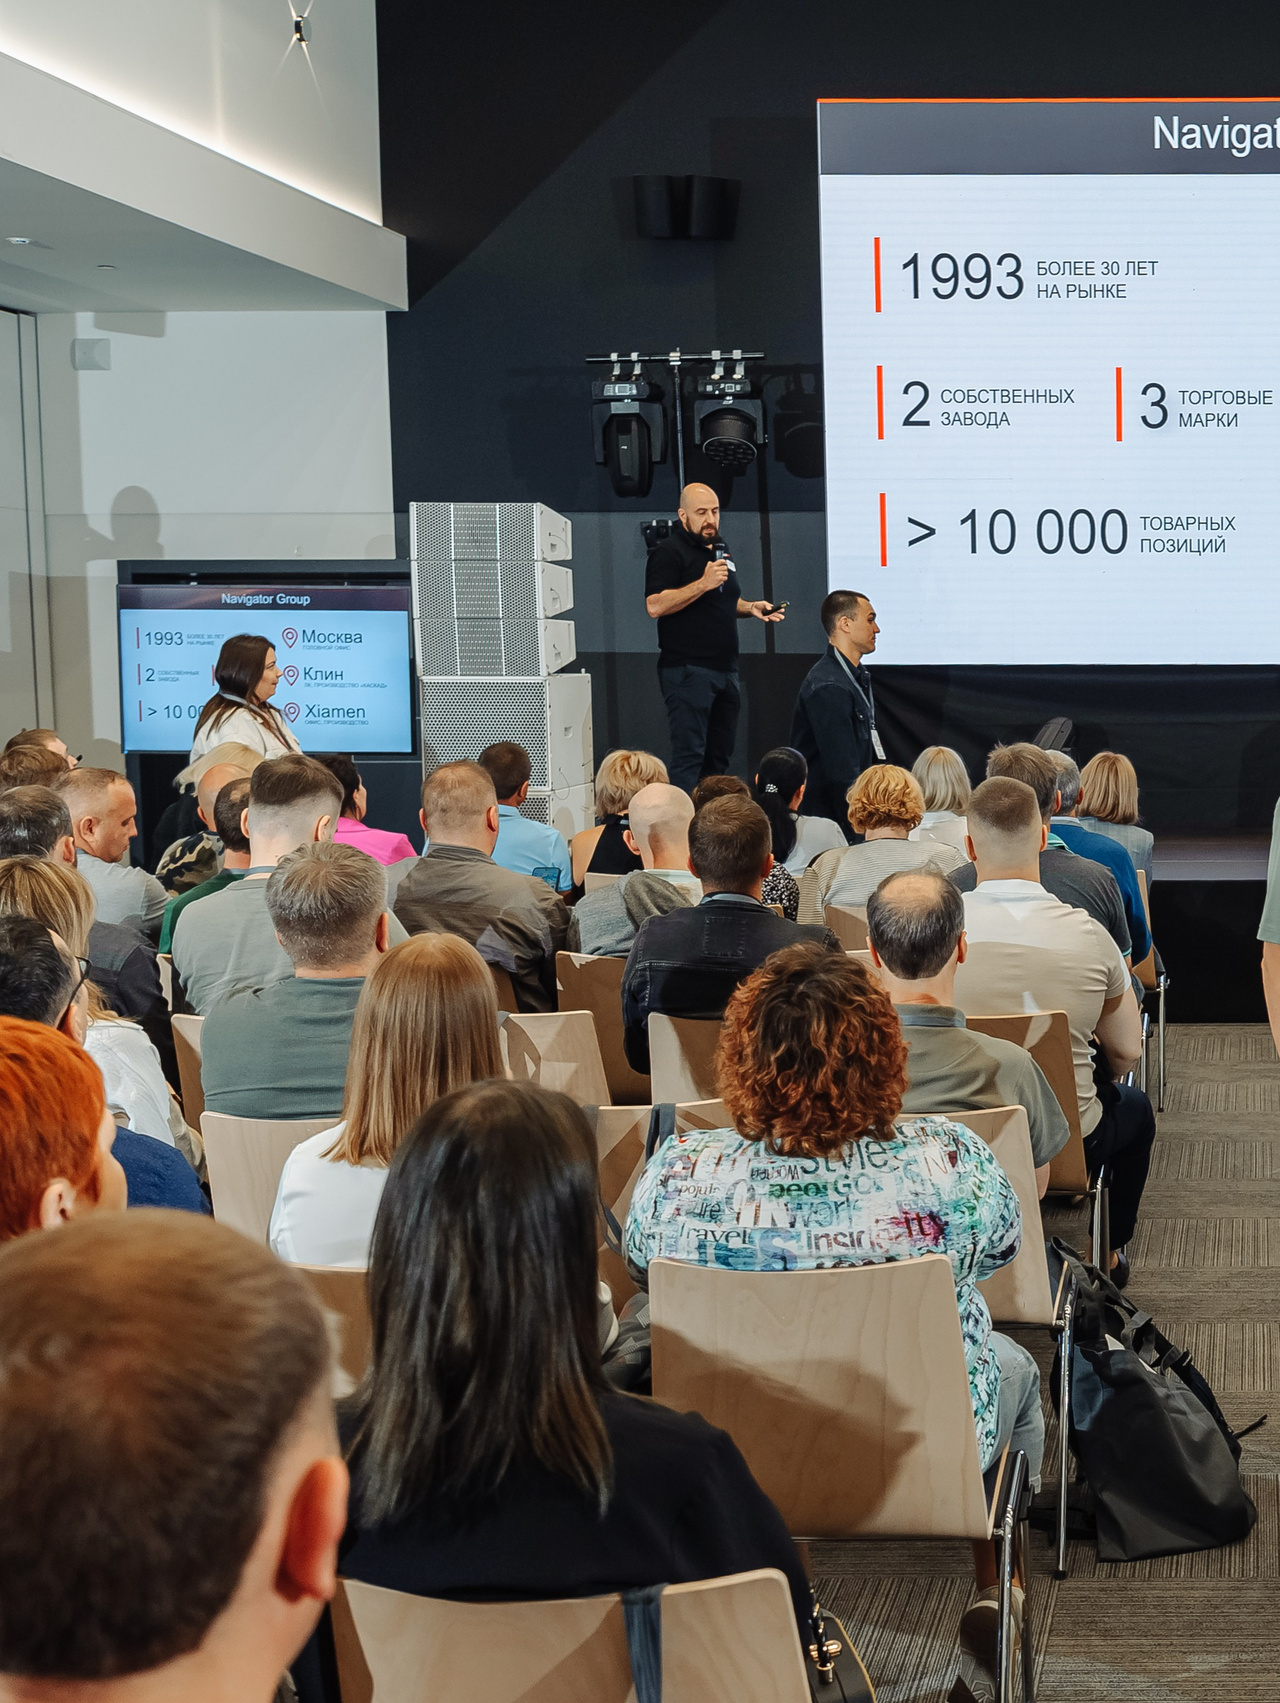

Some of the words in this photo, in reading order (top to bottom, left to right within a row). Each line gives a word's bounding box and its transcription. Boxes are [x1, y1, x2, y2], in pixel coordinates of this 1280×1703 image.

[1038, 261, 1095, 275] БОЛЕЕ
[1101, 261, 1119, 275] 30
[1125, 261, 1158, 275] ЛЕТ
[903, 253, 1023, 299] 1993
[1038, 284, 1060, 298] НА
[1067, 284, 1126, 298] РЫНКЕ
[941, 389, 1074, 403] СОБСТВЕННЫХ
[1178, 390, 1273, 404] ТОРГОВЫЕ
[902, 381, 930, 426] 2
[1141, 383, 1168, 429] 3
[941, 412, 1010, 429] ЗАВОДА
[1180, 413, 1237, 427] МАРКИ
[1140, 517, 1235, 530] ТОВАРНЫХ
[961, 509, 1016, 554] 10
[1037, 509, 1127, 554] 000
[1141, 536, 1225, 556] ПОЗИЦИЙ
[221, 592, 274, 606] Navigator
[276, 592, 311, 606] Group
[145, 631, 183, 646] 1993
[302, 629, 363, 644] Москва
[145, 667, 155, 682] 2
[303, 667, 344, 681] Клин
[164, 705, 182, 719] 10
[305, 704, 366, 718] Xiamen
